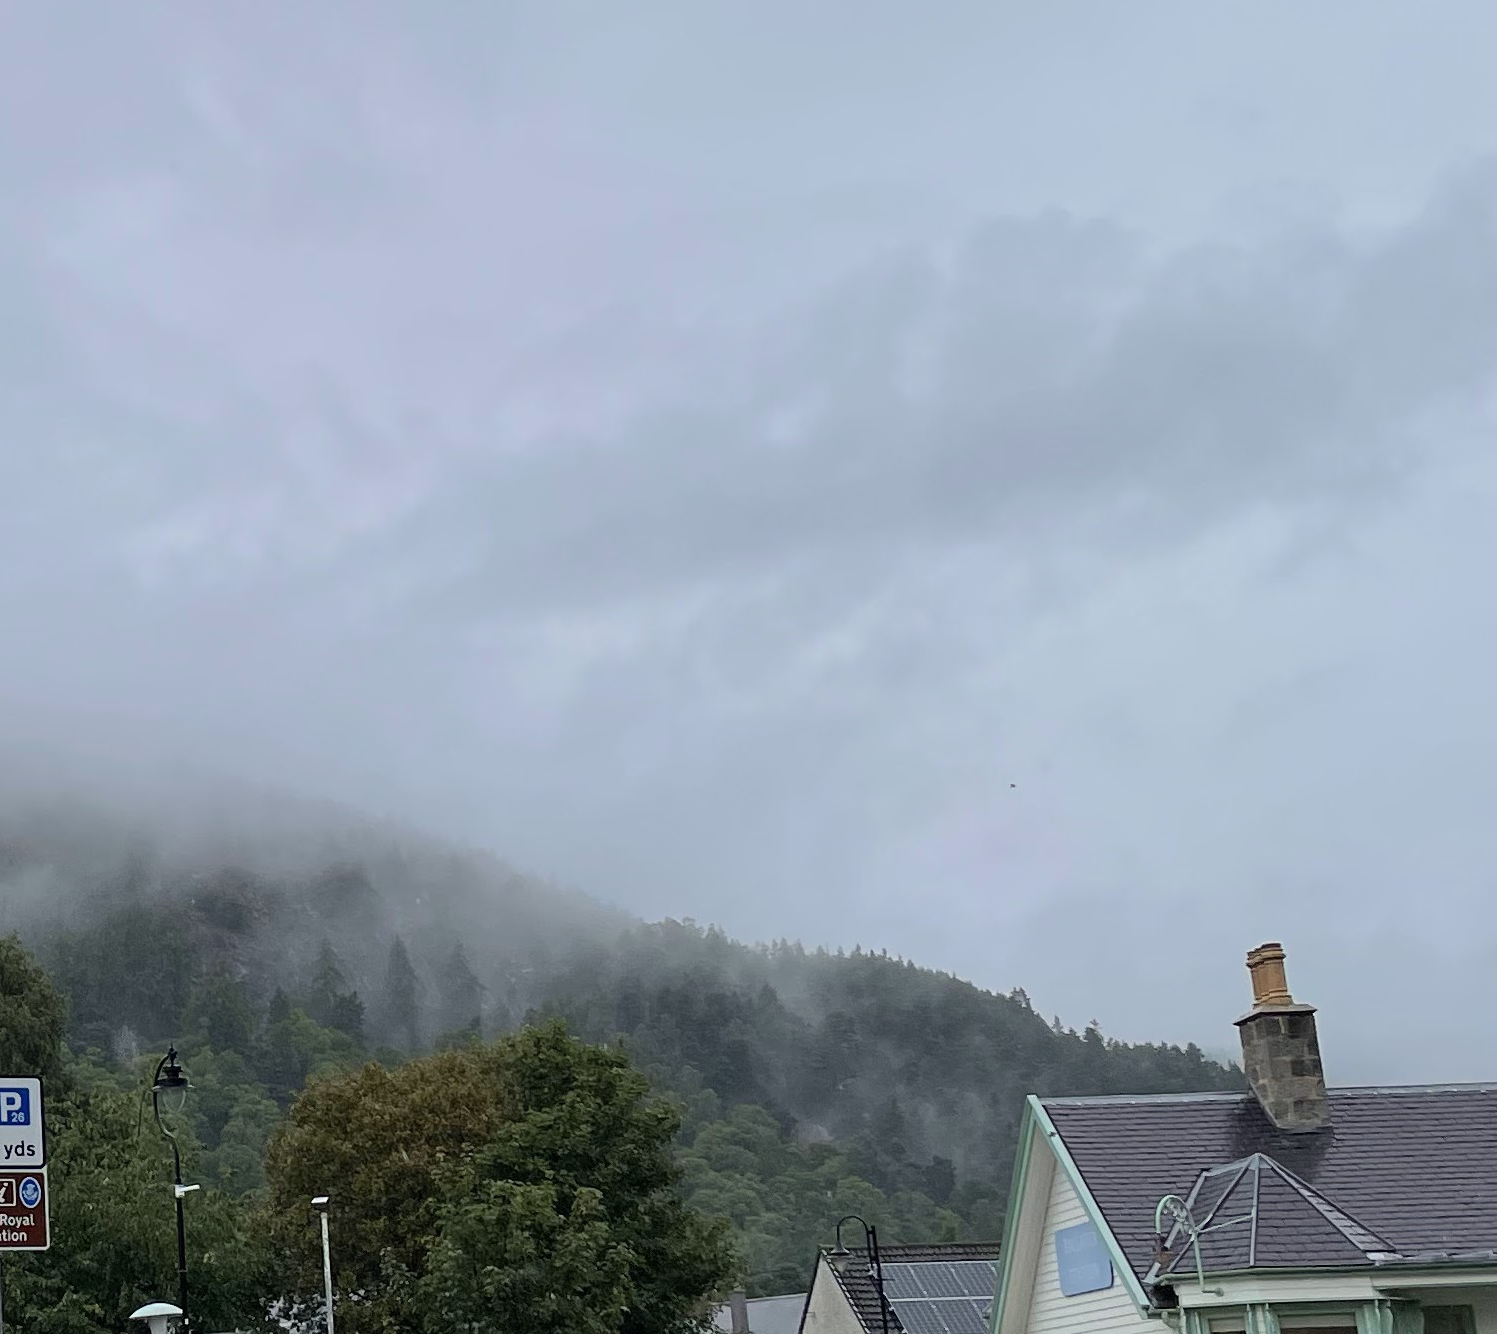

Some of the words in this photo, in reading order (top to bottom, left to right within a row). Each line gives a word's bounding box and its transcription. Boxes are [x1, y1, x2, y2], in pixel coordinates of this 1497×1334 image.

[0, 1091, 22, 1123] P
[11, 1112, 25, 1123] 26
[4, 1139, 36, 1160] yds
[0, 1213, 35, 1229] Royal
